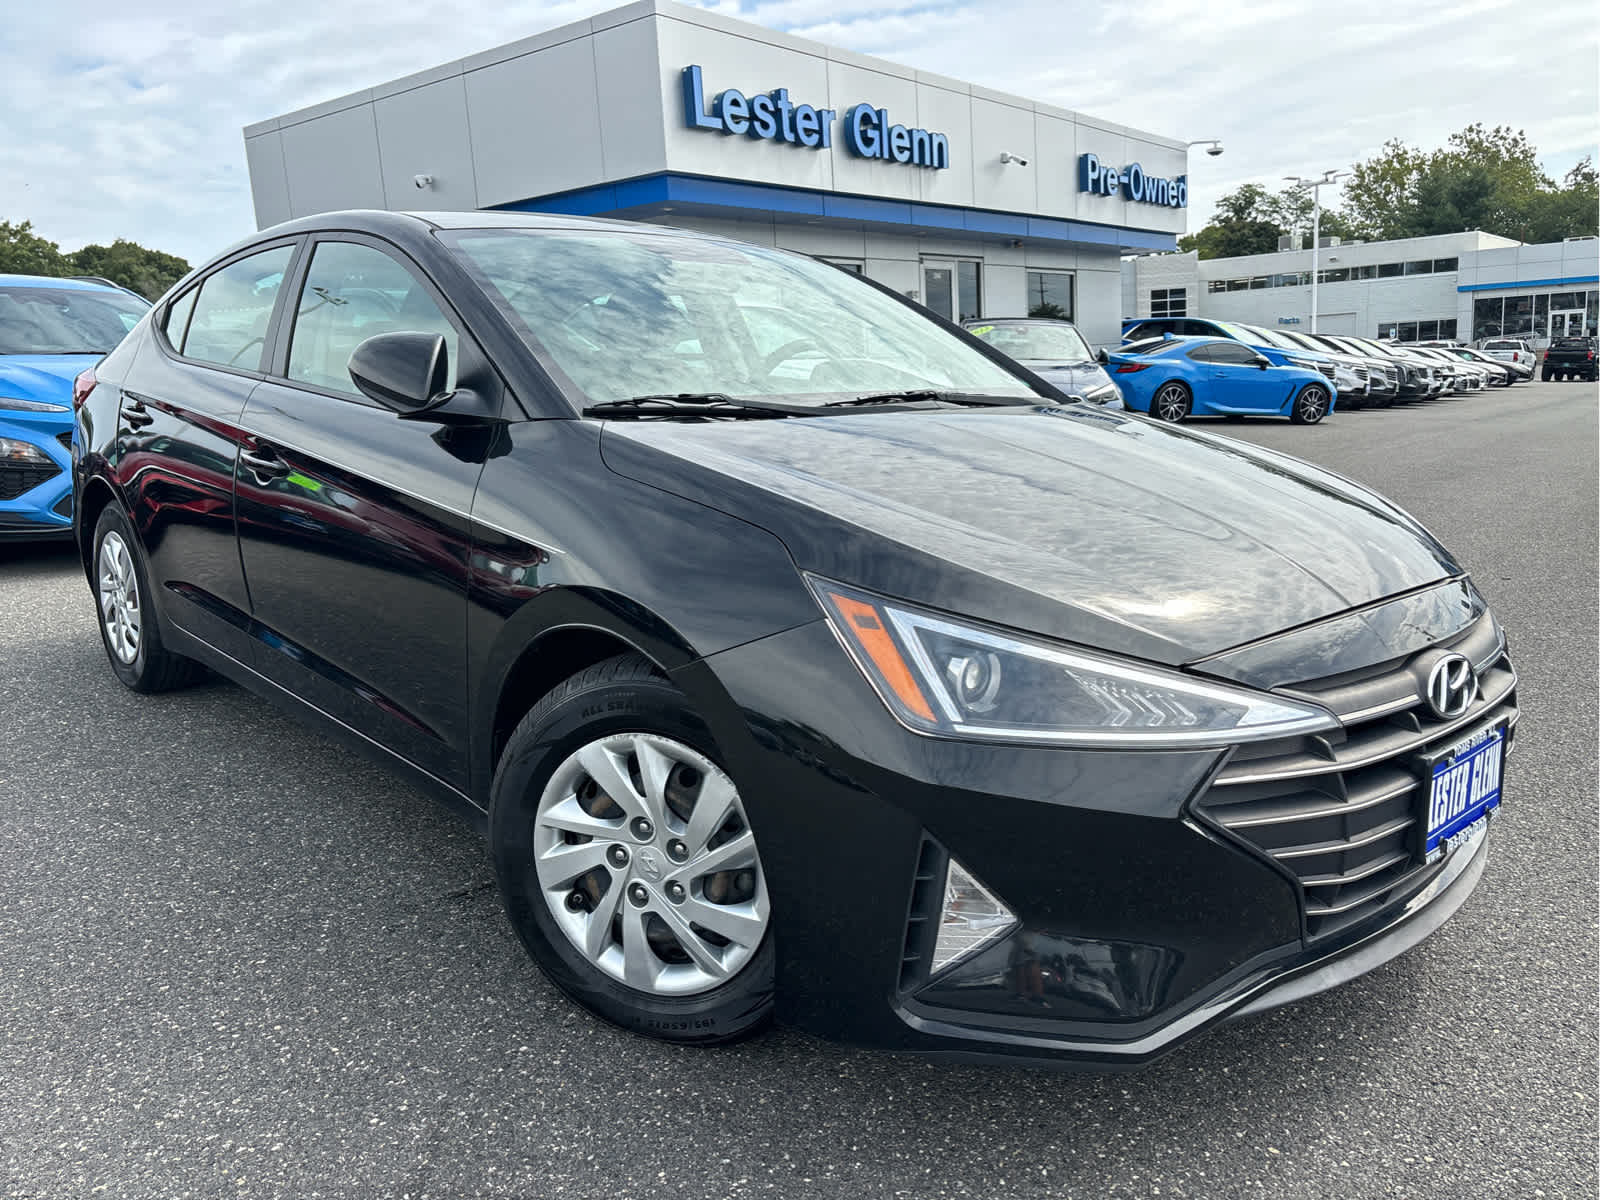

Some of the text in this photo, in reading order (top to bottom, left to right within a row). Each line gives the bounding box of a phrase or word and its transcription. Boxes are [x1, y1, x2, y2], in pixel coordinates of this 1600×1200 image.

[682, 65, 949, 169] Lester Glenn
[1078, 153, 1187, 208] Pre-Owned
[1427, 739, 1503, 833] LESTER GLENN
